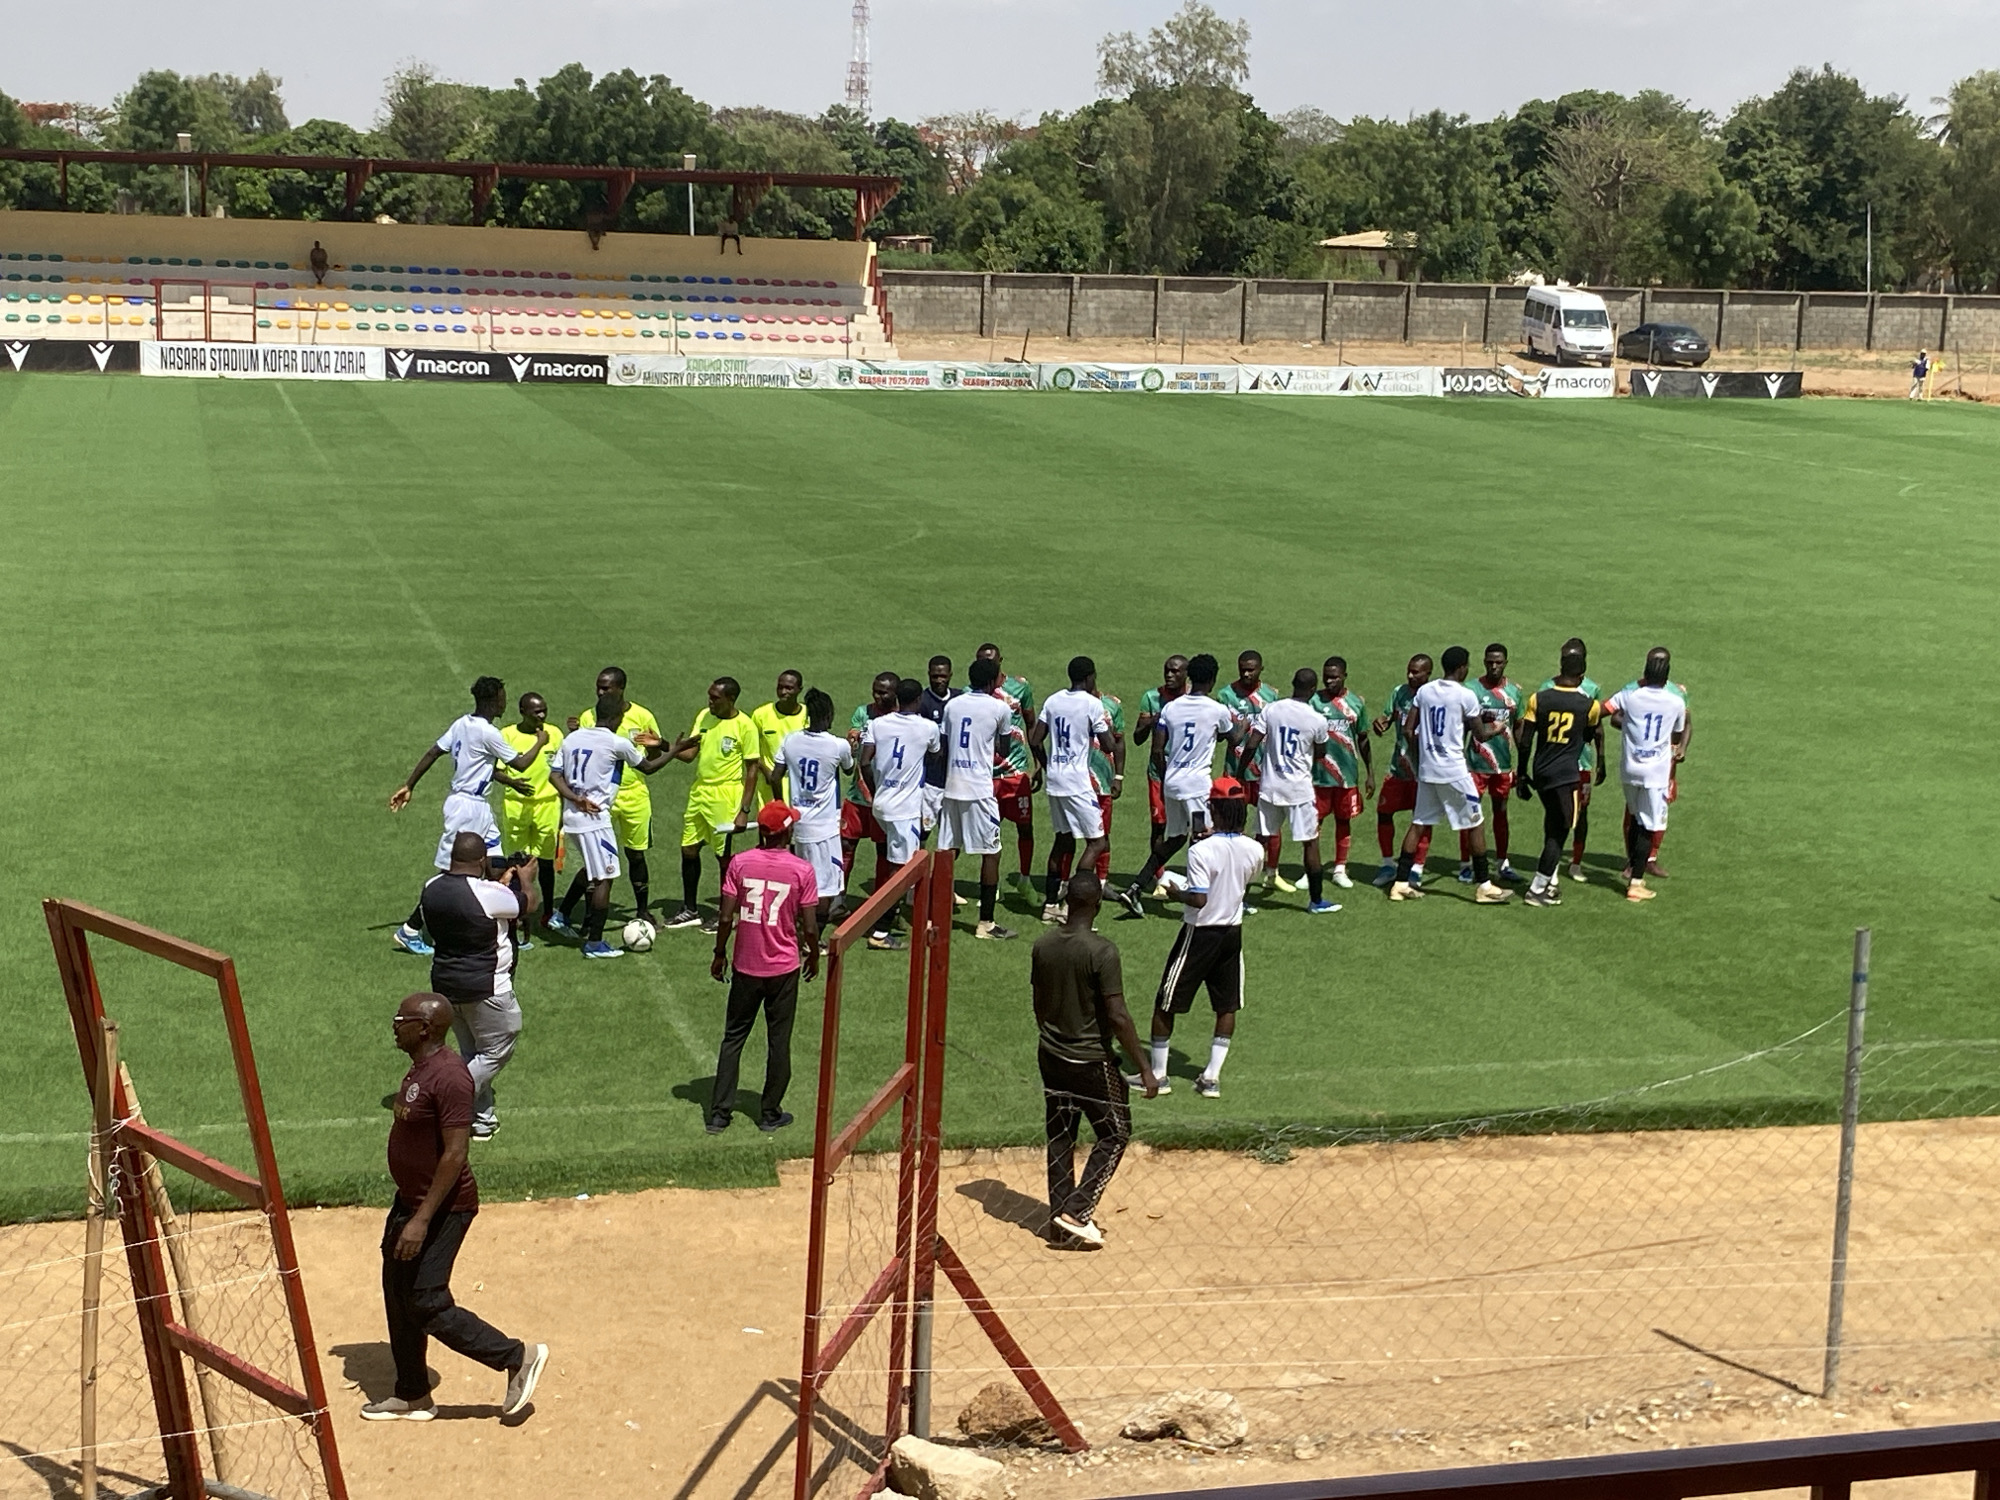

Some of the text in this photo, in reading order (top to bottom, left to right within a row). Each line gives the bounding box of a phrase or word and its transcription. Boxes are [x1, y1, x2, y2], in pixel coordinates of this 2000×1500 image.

[160, 347, 366, 374] NASARA STADIUM KOFAR DOKA ZARIA
[417, 359, 490, 375] macron
[533, 362, 604, 378] macron
[686, 358, 748, 372] KADUNA STATE
[642, 372, 790, 388] MINISTRY OF SPORTS DEVELOPMENT
[858, 376, 886, 384] SEASON
[1556, 376, 1611, 390] macron
[960, 717, 972, 748] 6
[1055, 716, 1070, 748] 14
[1430, 706, 1446, 737] 10
[1546, 711, 1574, 744] 22
[1644, 712, 1663, 742] 11
[1183, 722, 1196, 752] 5
[1279, 726, 1300, 758] 15
[572, 748, 592, 783] 17
[892, 737, 905, 770] 4
[799, 758, 820, 791] 19
[740, 878, 792, 926] 37
